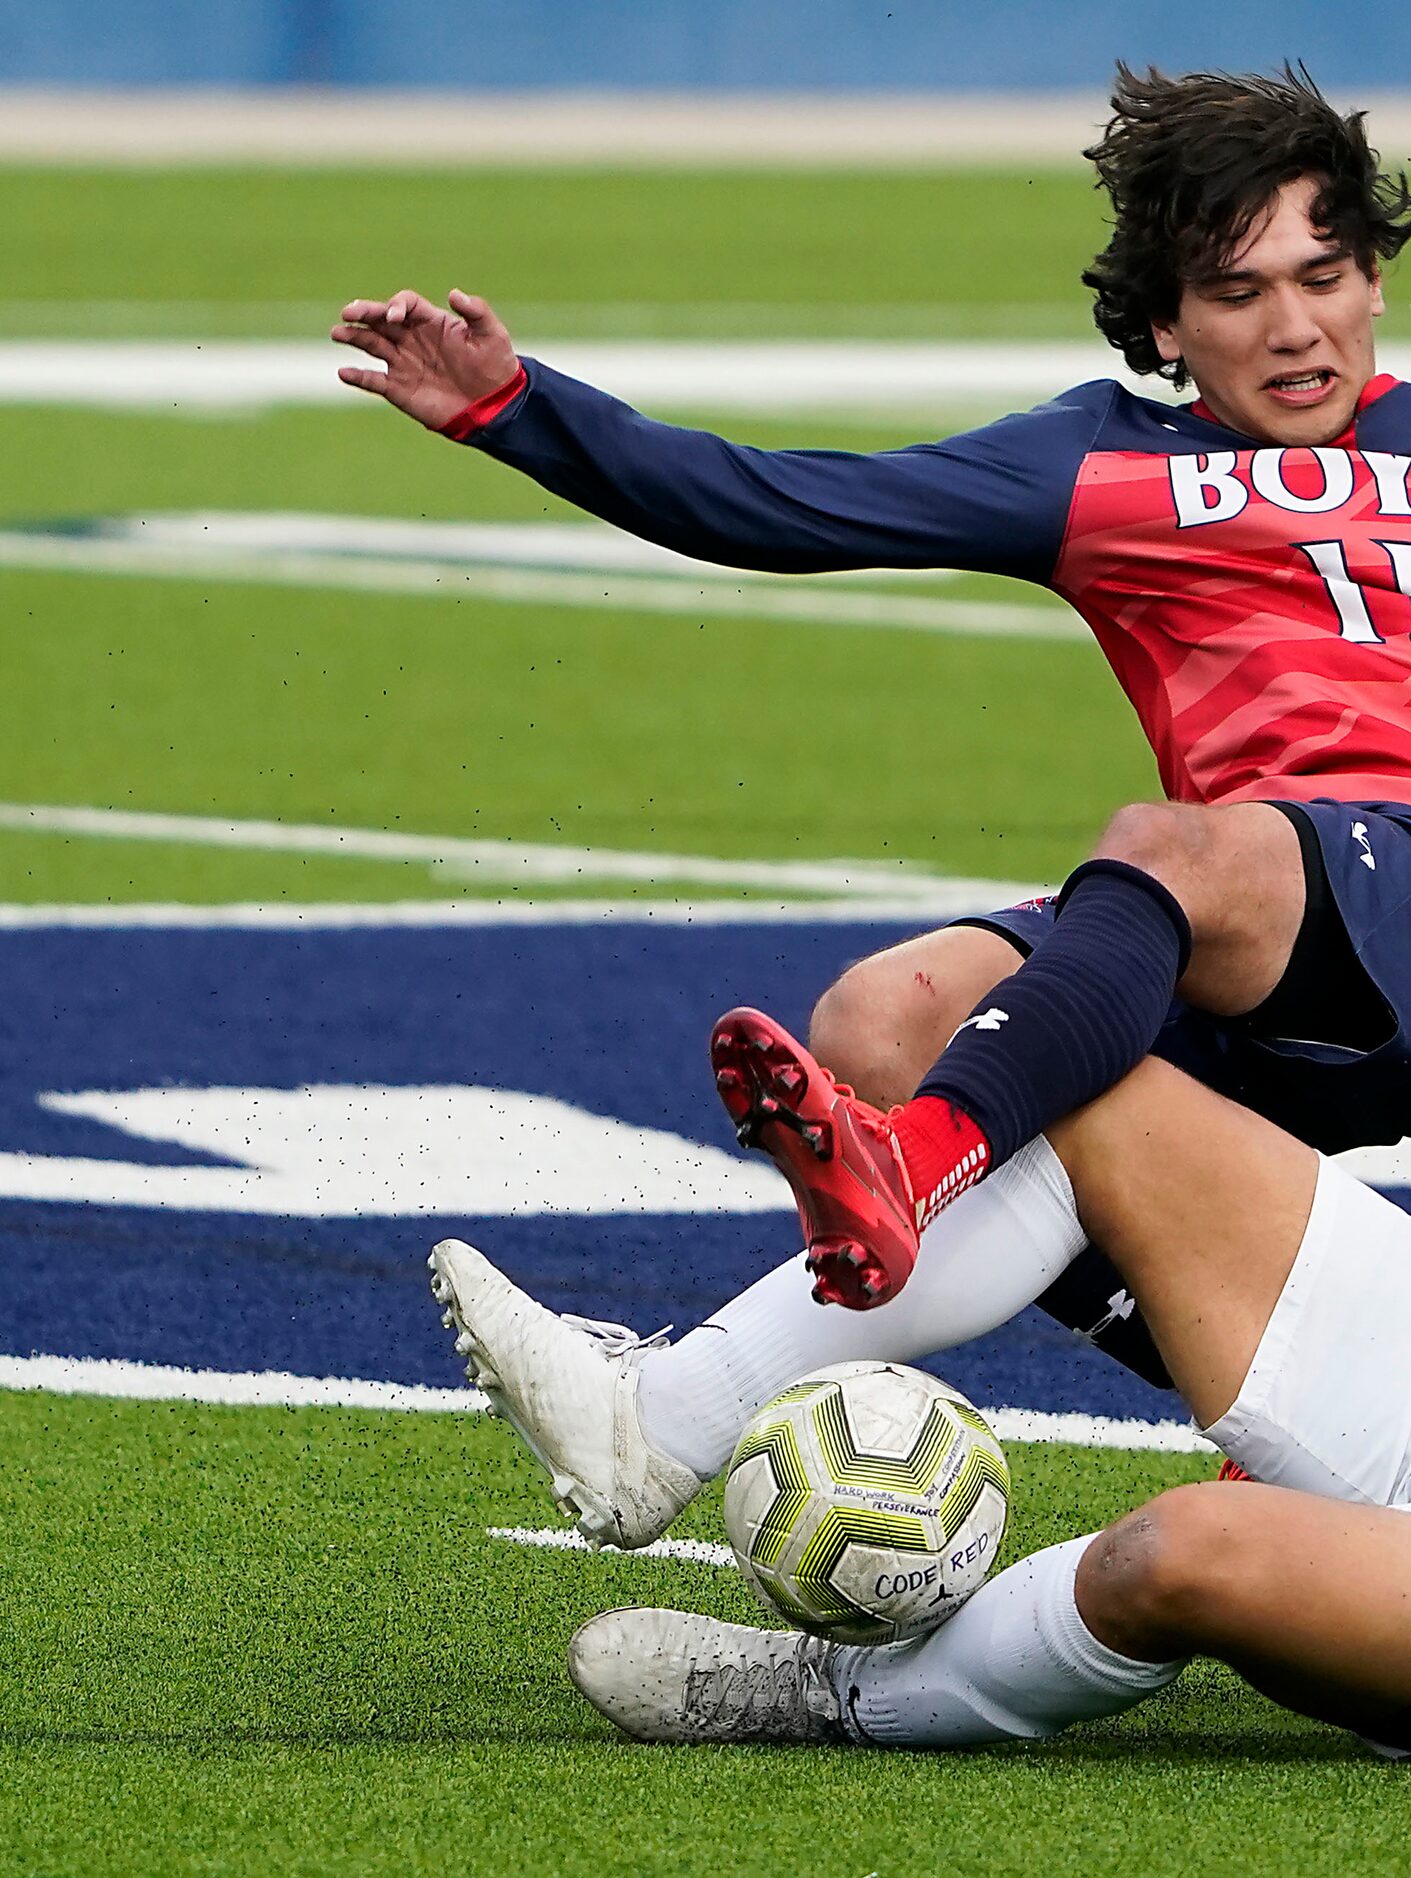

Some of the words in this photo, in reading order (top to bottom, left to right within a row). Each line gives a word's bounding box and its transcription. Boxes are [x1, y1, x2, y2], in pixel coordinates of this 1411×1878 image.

[834, 1484, 863, 1497] HARD
[866, 1490, 895, 1501] WORK
[924, 1482, 939, 1501] JOY
[872, 1501, 940, 1518] PERSEVERANCE
[875, 1565, 938, 1600] CODE
[950, 1533, 989, 1572] RED
